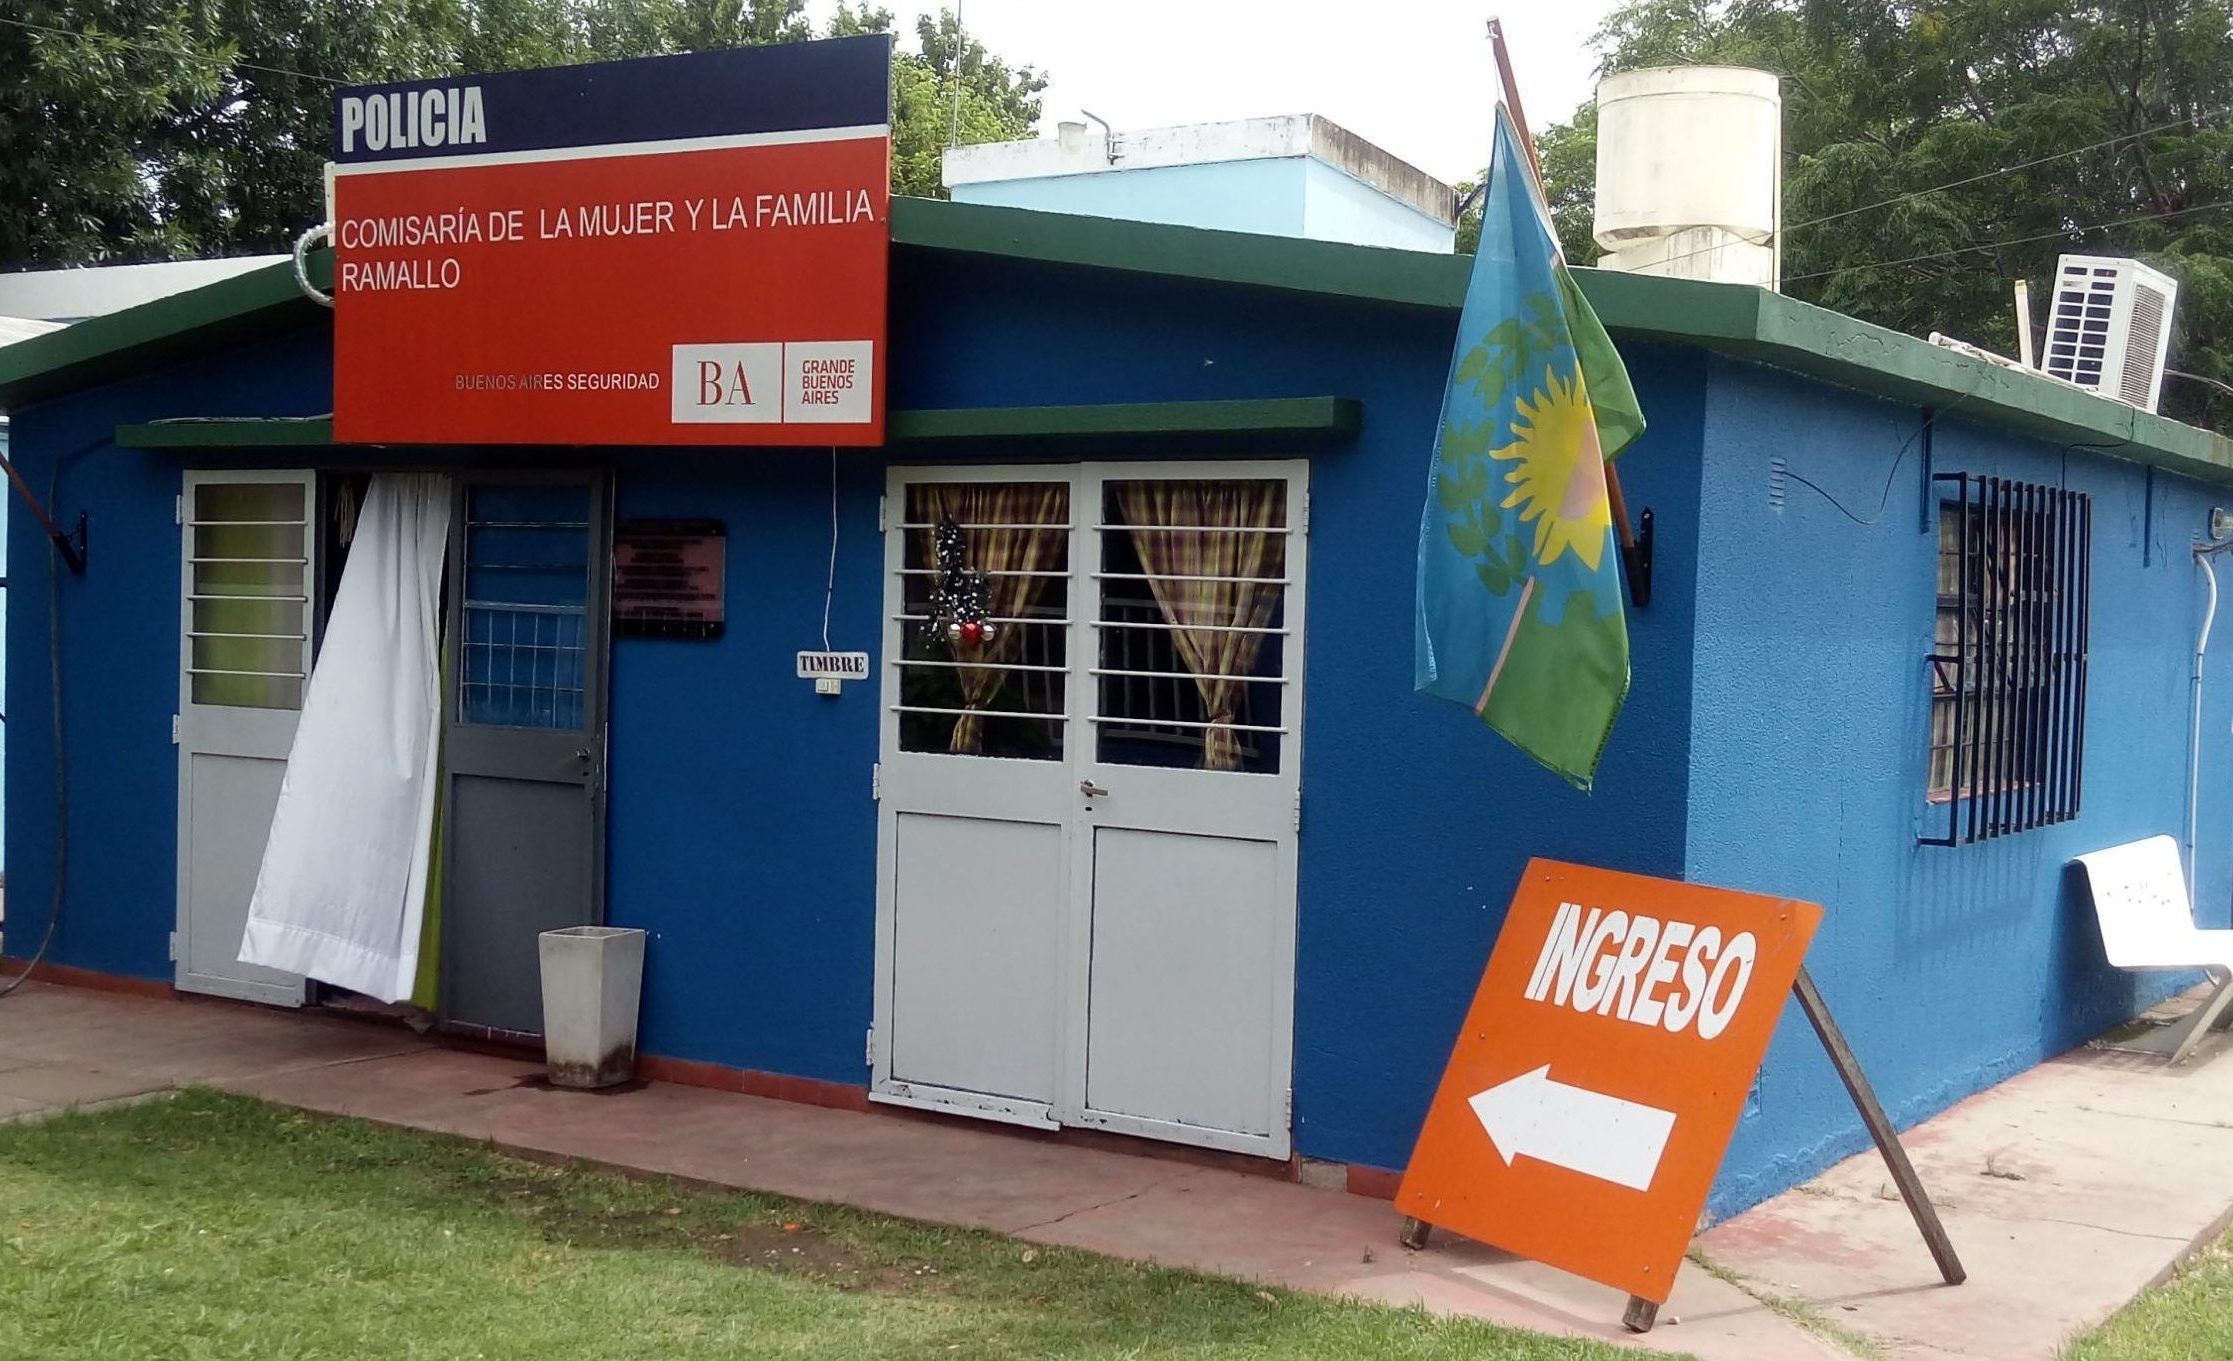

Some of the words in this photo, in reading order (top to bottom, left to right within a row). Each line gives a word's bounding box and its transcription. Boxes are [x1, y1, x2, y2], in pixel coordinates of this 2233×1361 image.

[342, 86, 487, 153] POLICIA
[342, 206, 482, 249] COMISARÍA
[489, 210, 523, 242] DE
[540, 207, 572, 239] LA
[579, 201, 675, 237] MUJER
[685, 198, 705, 231] Y
[712, 196, 747, 230] LA
[756, 188, 874, 228] FAMILIA
[342, 258, 460, 292] RAMALLO
[802, 359, 856, 375] GRANDE
[456, 373, 516, 390] BUENOS
[519, 373, 563, 390] AIRES
[567, 372, 660, 390] SEGURIDAD
[697, 360, 756, 407] BA
[802, 375, 853, 390] BUENOS
[802, 390, 839, 405] AIRES
[800, 655, 865, 673] TIMBRE
[1524, 902, 1757, 1040] INGRESO
